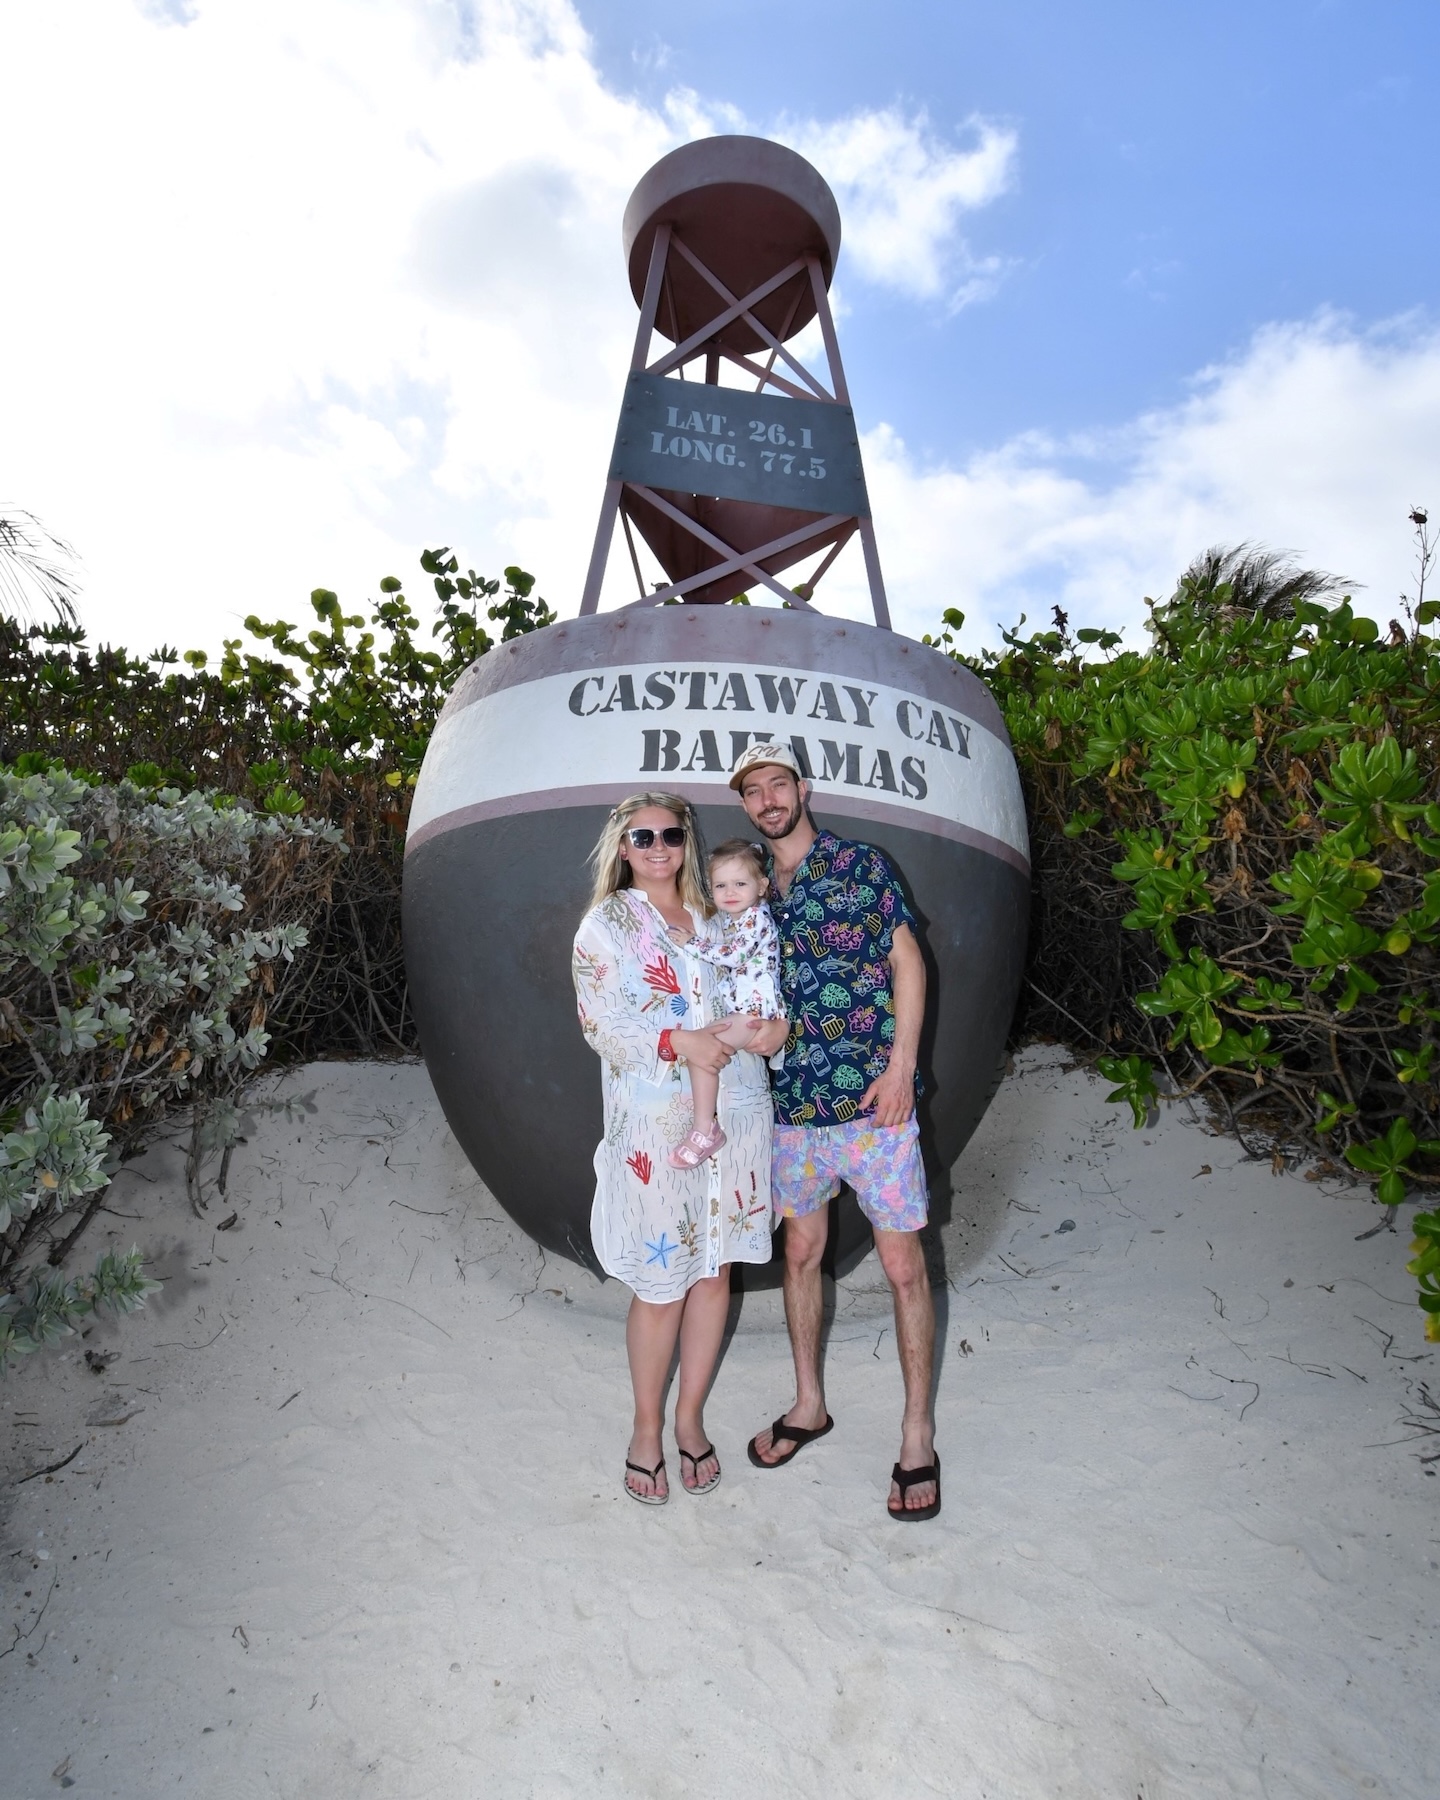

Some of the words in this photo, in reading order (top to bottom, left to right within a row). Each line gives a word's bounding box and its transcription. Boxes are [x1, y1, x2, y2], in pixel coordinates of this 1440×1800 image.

[666, 406, 736, 438] LAT.
[748, 420, 814, 449] 26.1
[650, 431, 746, 468] LONG.
[760, 450, 827, 480] 77.5
[568, 671, 879, 729] CASTAWAY
[895, 699, 972, 760] CAY
